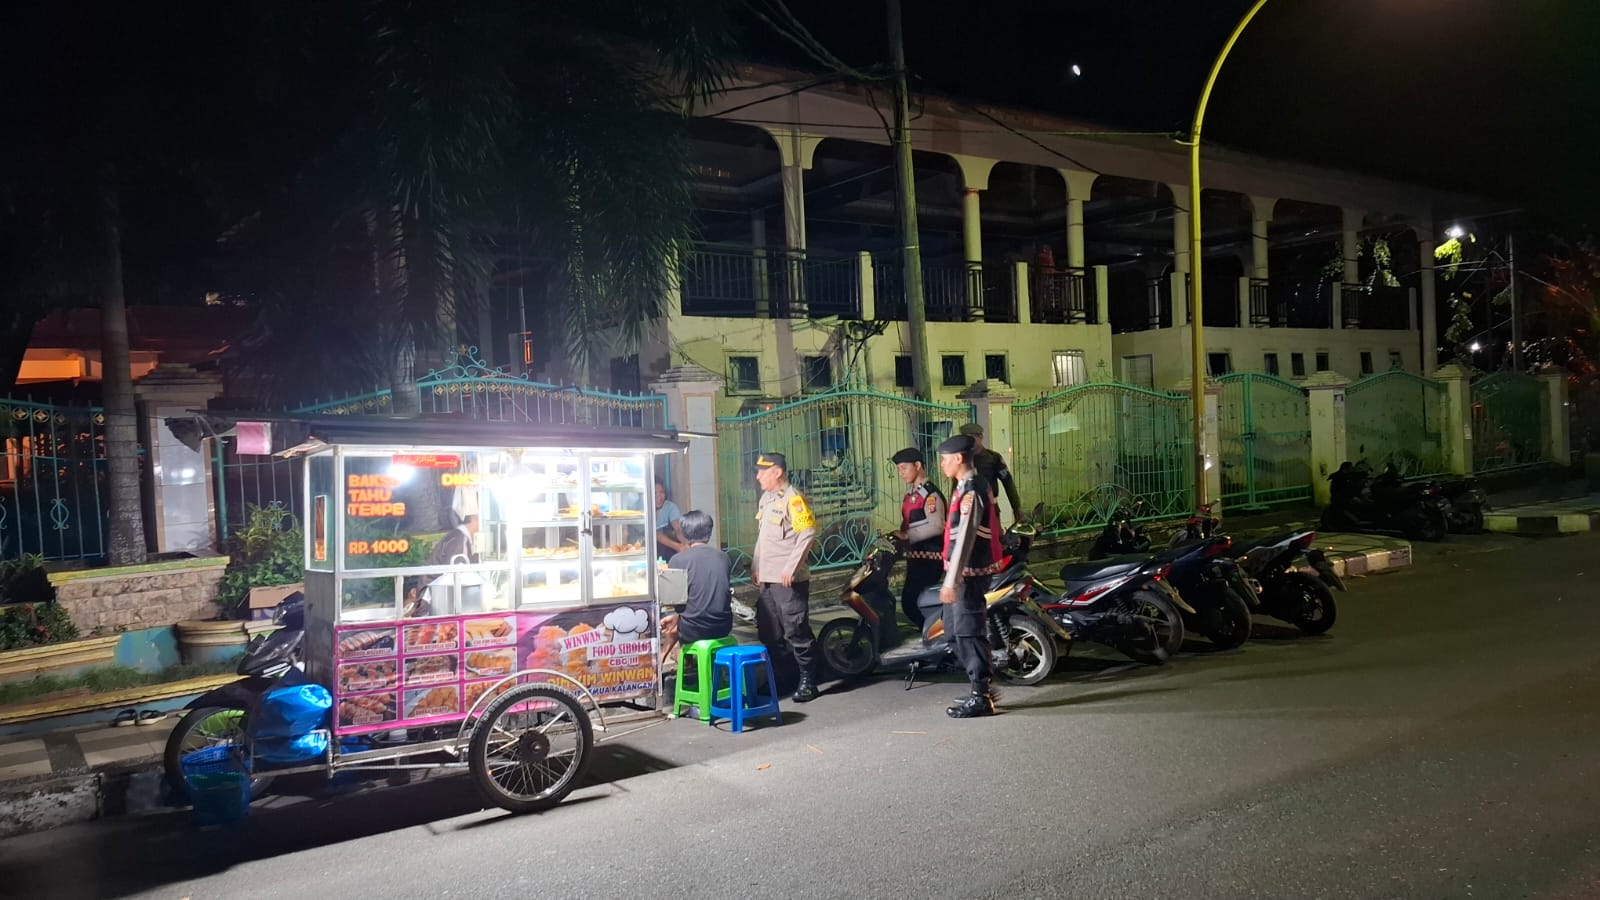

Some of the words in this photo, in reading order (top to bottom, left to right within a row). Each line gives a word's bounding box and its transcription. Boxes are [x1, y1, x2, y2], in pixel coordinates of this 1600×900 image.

[348, 488, 392, 502] TAHU
[348, 503, 405, 516] TEMPE
[348, 541, 369, 554] RP.
[371, 539, 409, 553] 1000
[564, 631, 602, 649] WINWAN
[592, 644, 616, 657] FOOD
[601, 667, 653, 683] WINWAN
[612, 681, 653, 694] KALANGAN
